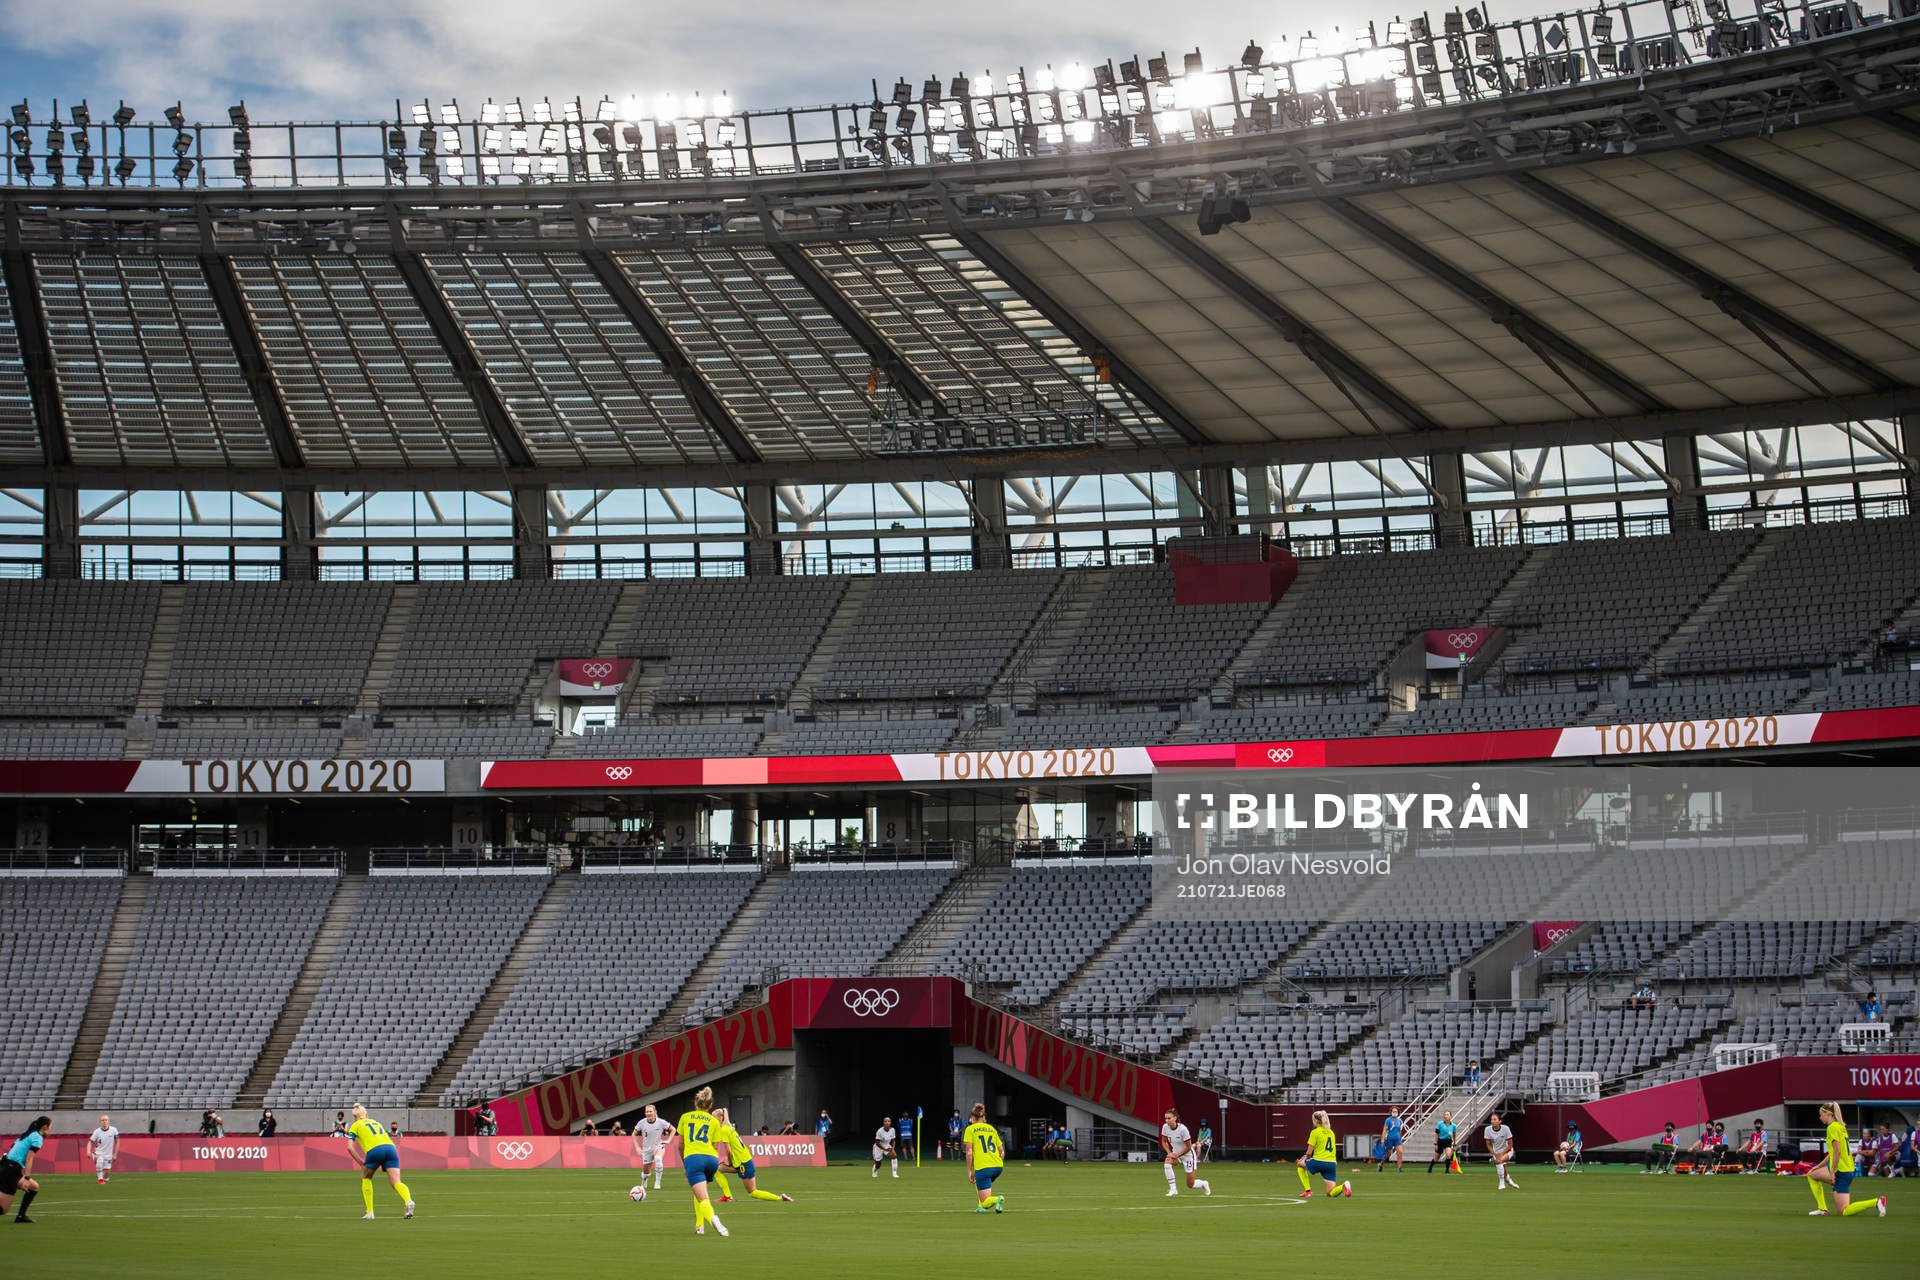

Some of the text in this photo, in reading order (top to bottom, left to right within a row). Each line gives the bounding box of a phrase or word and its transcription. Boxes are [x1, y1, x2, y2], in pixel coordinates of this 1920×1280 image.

[1595, 716, 1778, 755] TOKYO 2020
[934, 748, 1115, 780] TOKYO 2020
[182, 760, 411, 792] TOKYO 2020
[21, 829, 41, 846] 12
[242, 829, 259, 845] 11
[457, 827, 478, 845] 10
[675, 825, 685, 842] 9
[886, 822, 896, 839] 8
[971, 1000, 1138, 1116] TOKYO 2020
[508, 1004, 776, 1136] TOKYO 2020
[1849, 1067, 1902, 1086] TOKYO
[688, 1122, 709, 1143] 14
[192, 1147, 268, 1159] TOKYO 2020
[749, 1143, 815, 1157] TOKYO 2020
[978, 1135, 996, 1153] 16
[1325, 1137, 1333, 1153] 4
